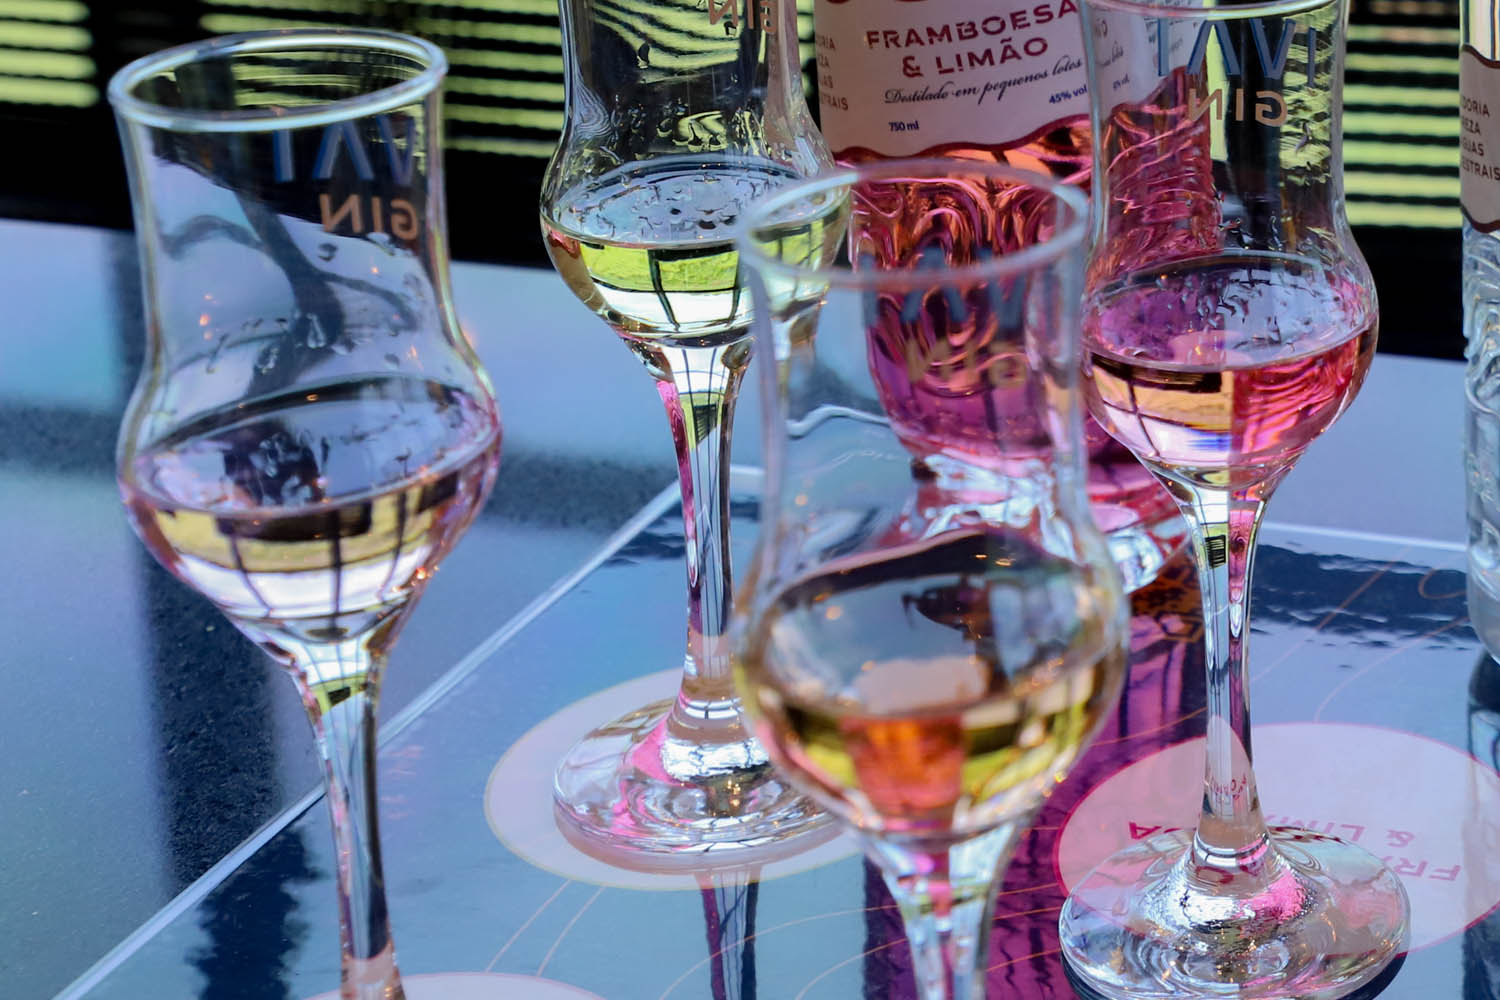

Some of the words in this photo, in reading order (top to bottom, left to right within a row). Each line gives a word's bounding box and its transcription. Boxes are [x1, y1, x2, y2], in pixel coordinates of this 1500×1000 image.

[901, 55, 924, 78] &
[935, 36, 1049, 75] LIMÃO
[883, 80, 954, 105] Destilado
[955, 86, 979, 99] em
[977, 69, 1048, 105] pequenos
[1051, 54, 1083, 76] lotes
[1048, 88, 1071, 105] 45%
[888, 121, 905, 132] 750
[906, 120, 919, 132] ml
